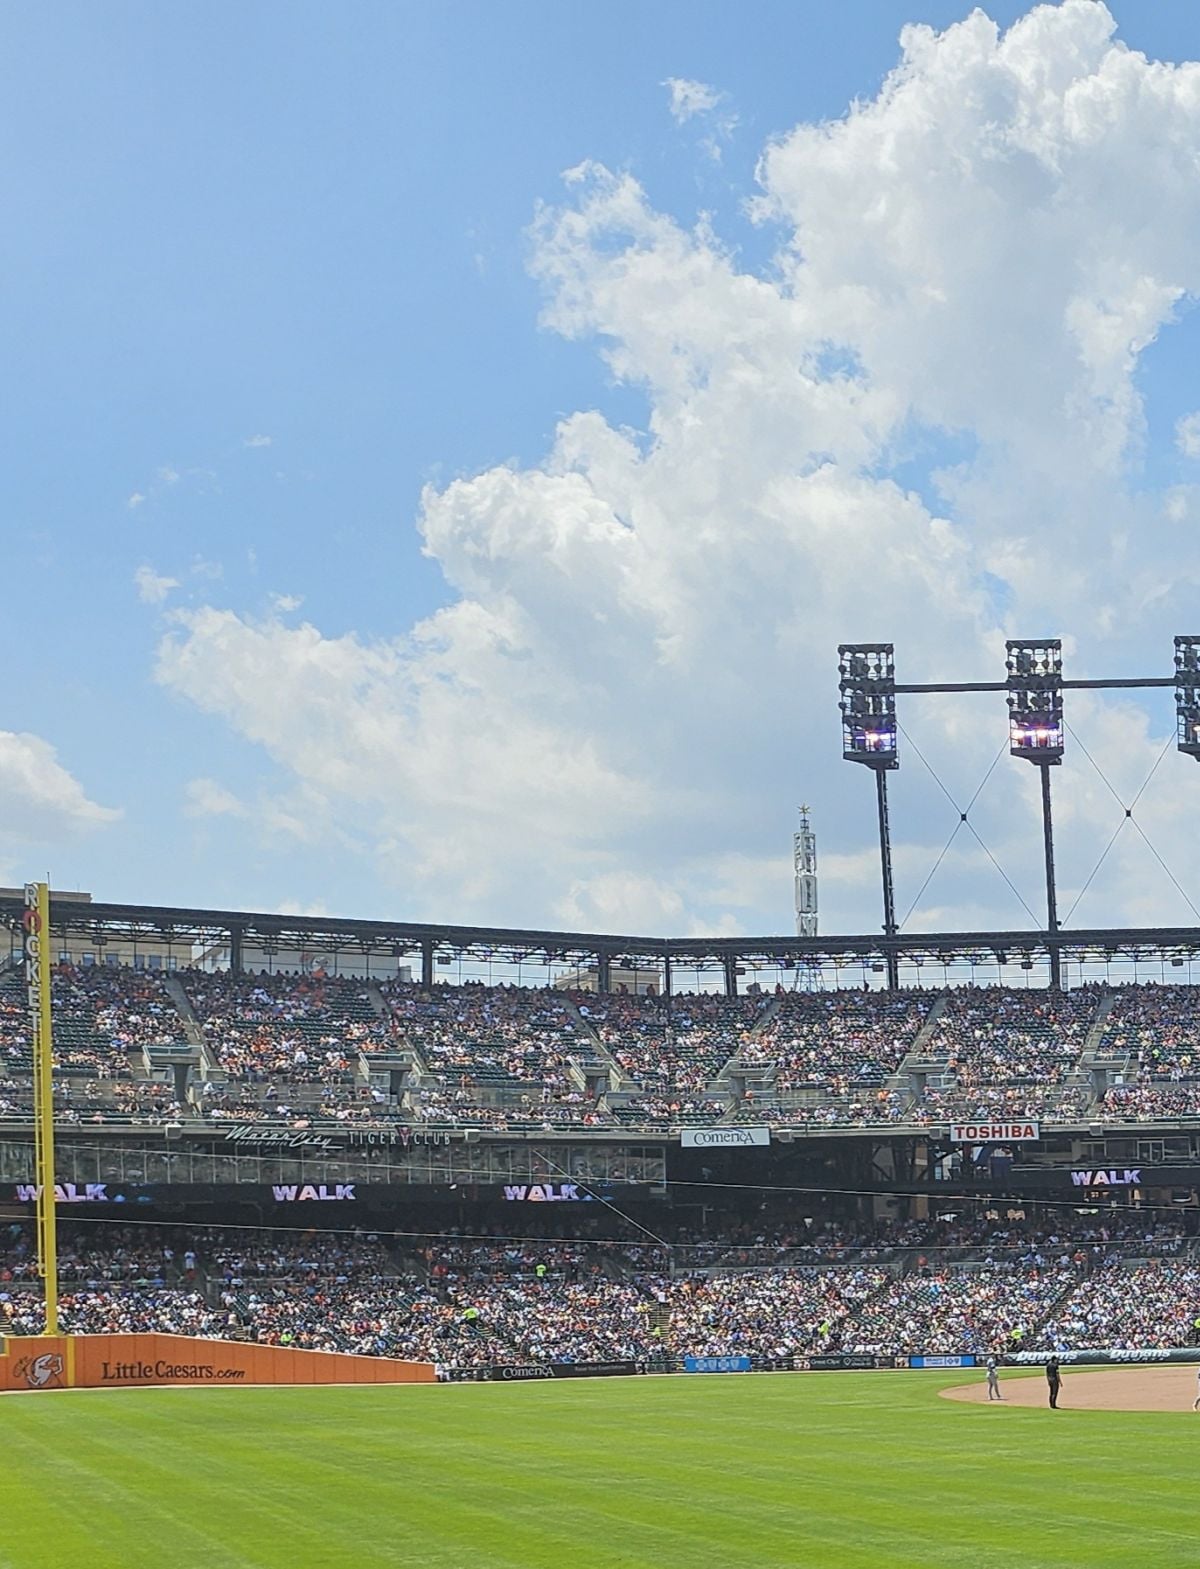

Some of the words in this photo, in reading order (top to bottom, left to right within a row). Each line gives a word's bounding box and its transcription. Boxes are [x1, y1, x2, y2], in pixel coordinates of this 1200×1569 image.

[22, 883, 42, 1034] ROCKET
[349, 1131, 397, 1145] TIGER
[413, 1132, 451, 1145] CLUB
[953, 1124, 1035, 1139] TOSHIBA
[1070, 1169, 1142, 1186] WALK
[16, 1183, 108, 1202] WALK
[271, 1184, 356, 1202] WALK
[503, 1183, 580, 1202] WALK
